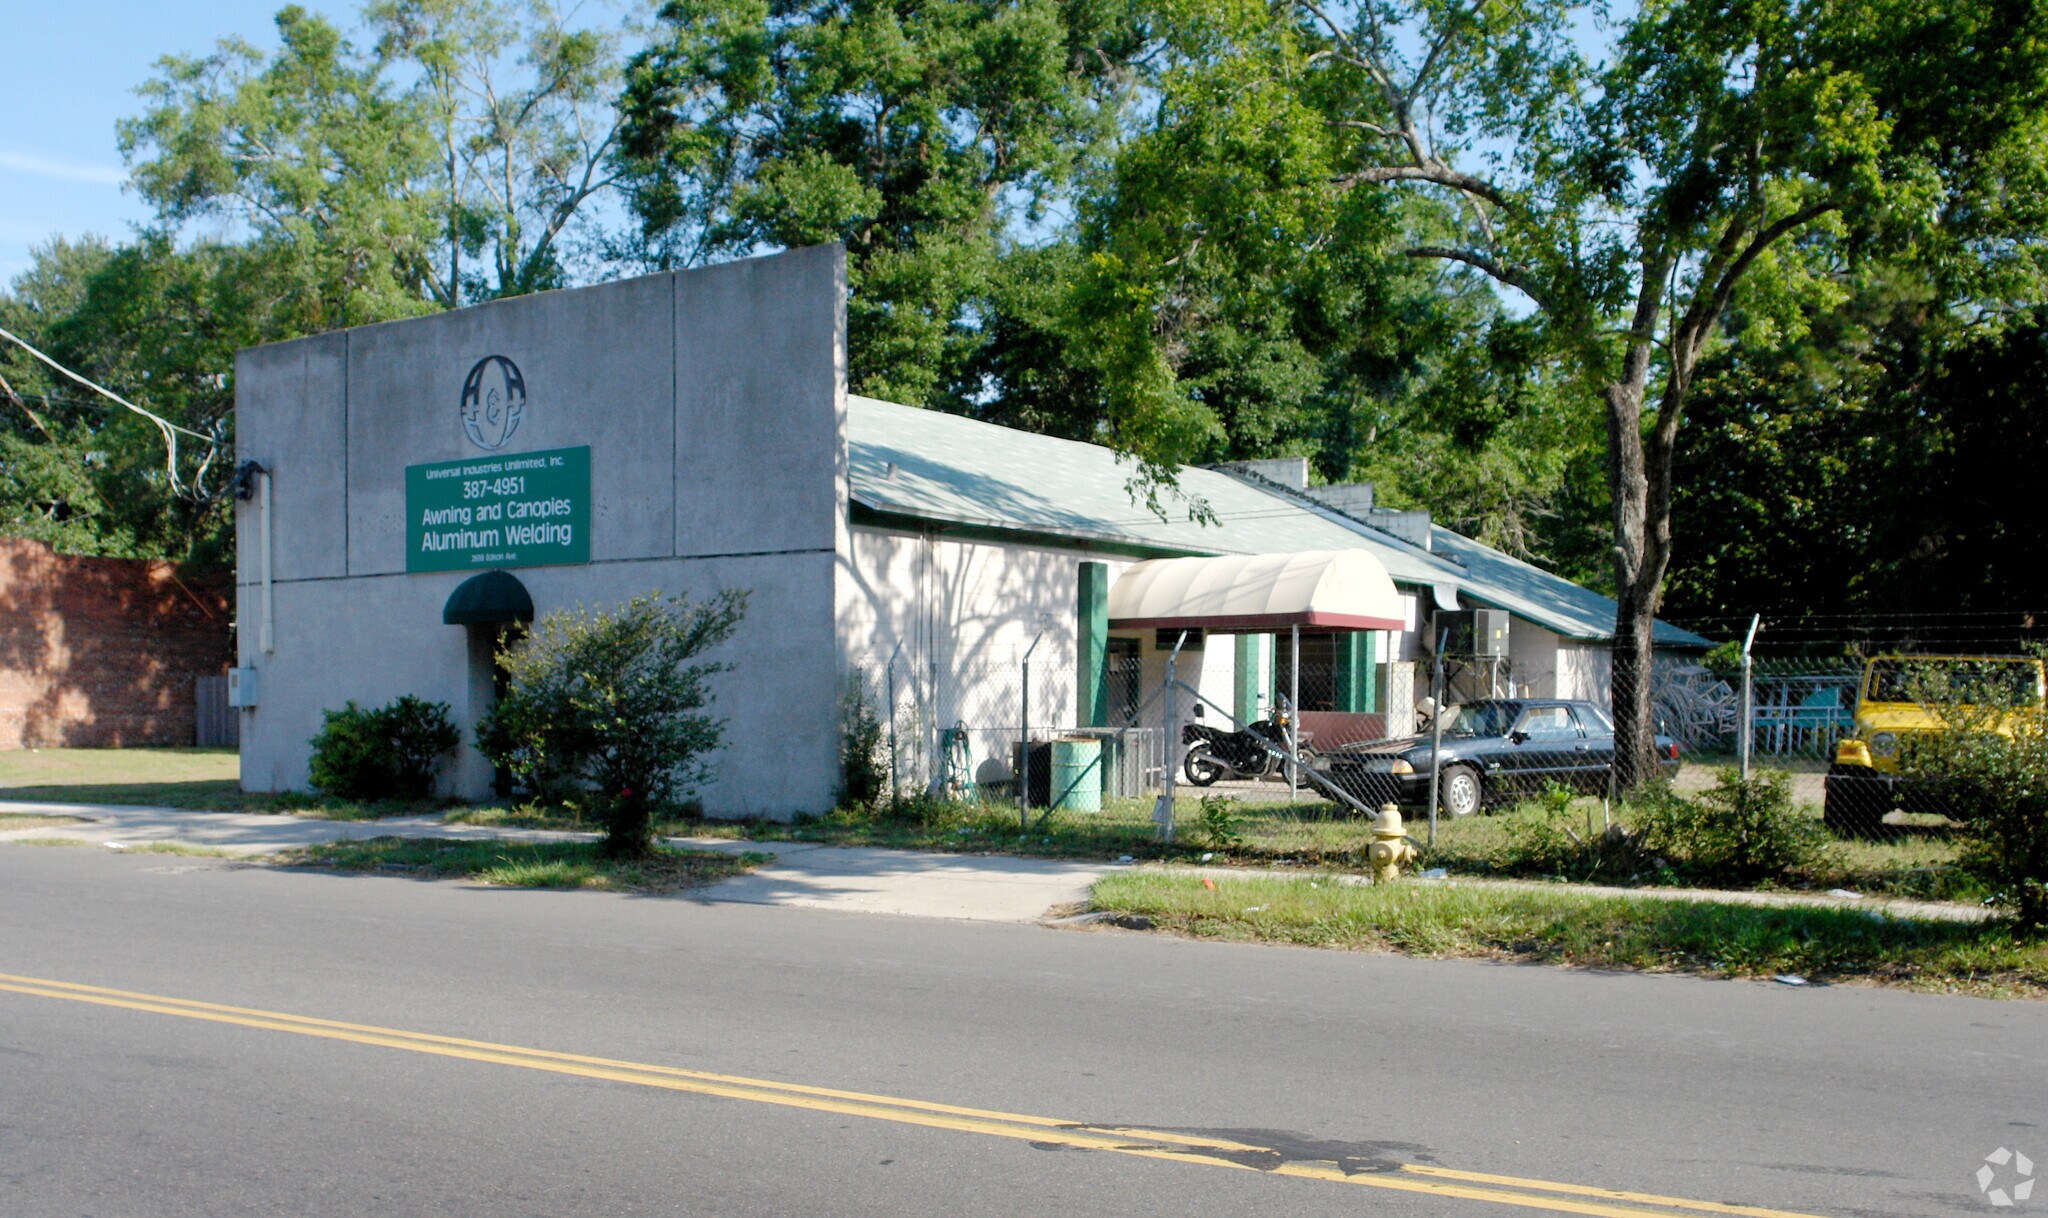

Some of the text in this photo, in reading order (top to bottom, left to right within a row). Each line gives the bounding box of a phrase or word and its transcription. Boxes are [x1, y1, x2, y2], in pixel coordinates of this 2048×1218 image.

[426, 456, 565, 480] Universal Industries Unlimited, Inc.
[463, 476, 525, 499] 387-4951
[422, 497, 571, 525] Awning and Canopies
[421, 522, 572, 552] Aluminum Welding
